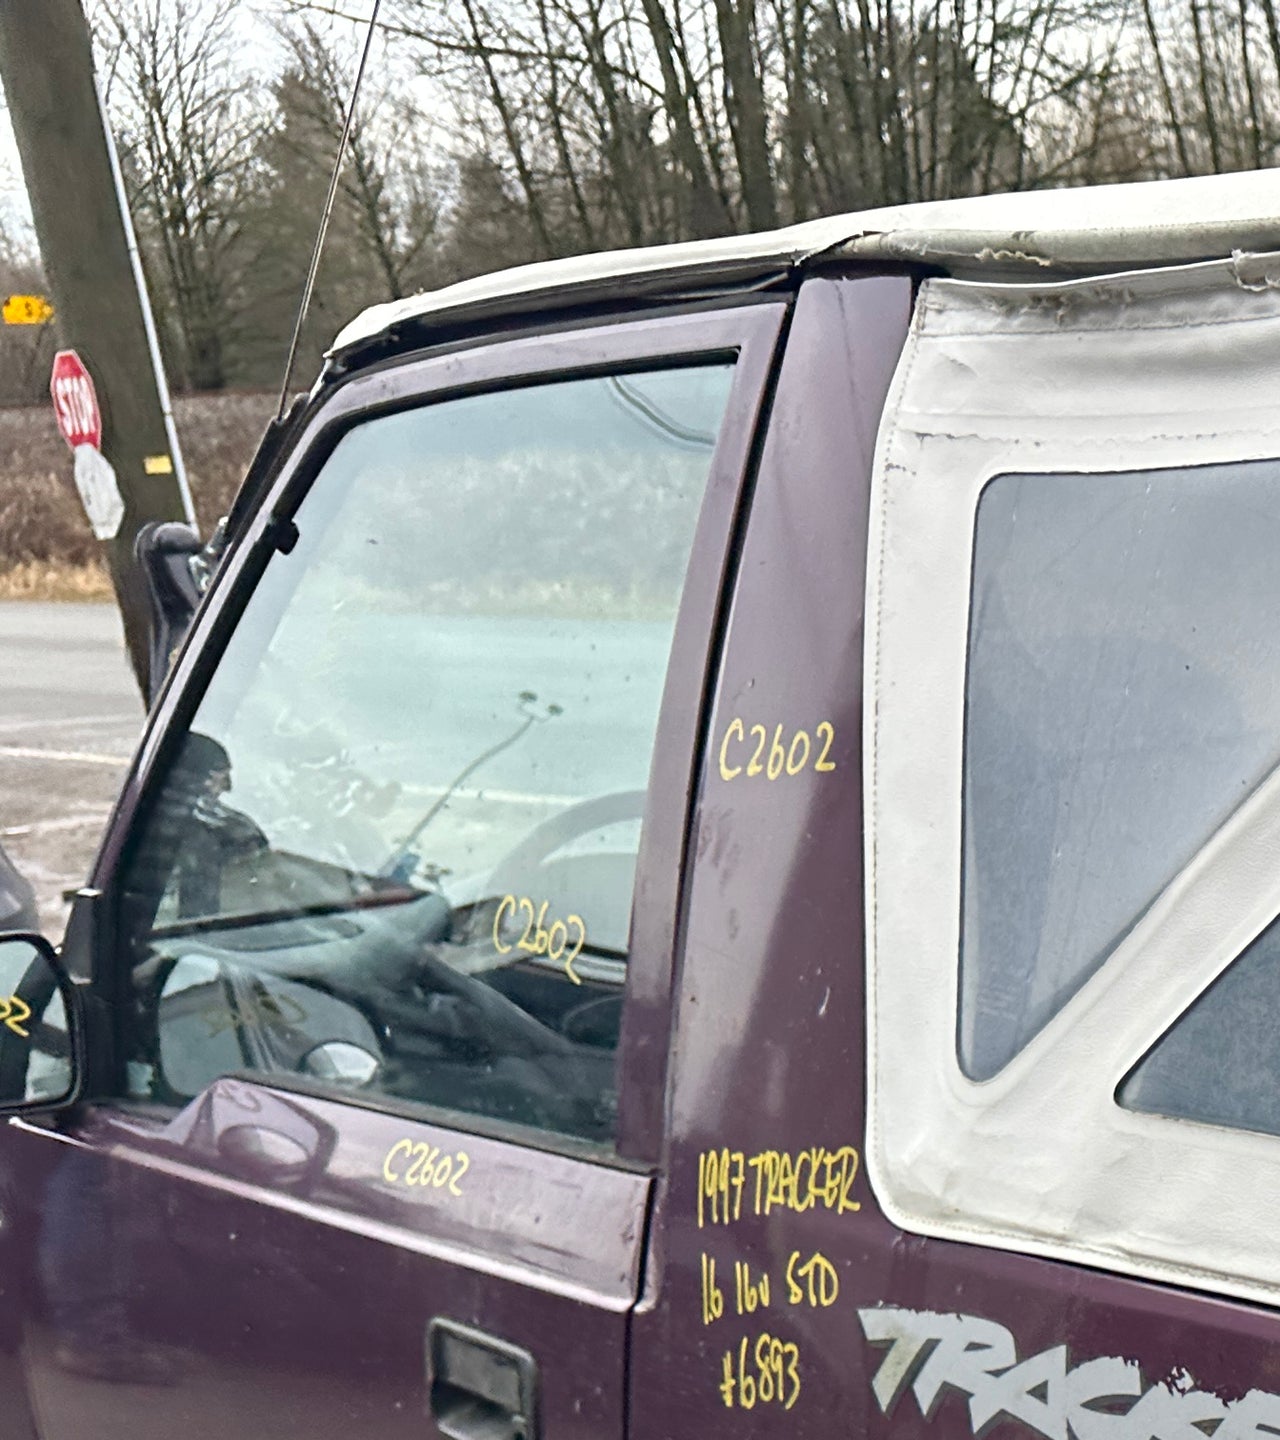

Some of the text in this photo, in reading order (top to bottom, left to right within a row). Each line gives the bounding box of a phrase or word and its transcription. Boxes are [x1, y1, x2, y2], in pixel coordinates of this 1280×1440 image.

[56, 375, 99, 436] STOP
[719, 717, 837, 781] C2602
[492, 894, 586, 986] C2602
[383, 1138, 470, 1196] C2602
[698, 1147, 861, 1228] 1997 TRACKER
[786, 1251, 839, 1307] STD
